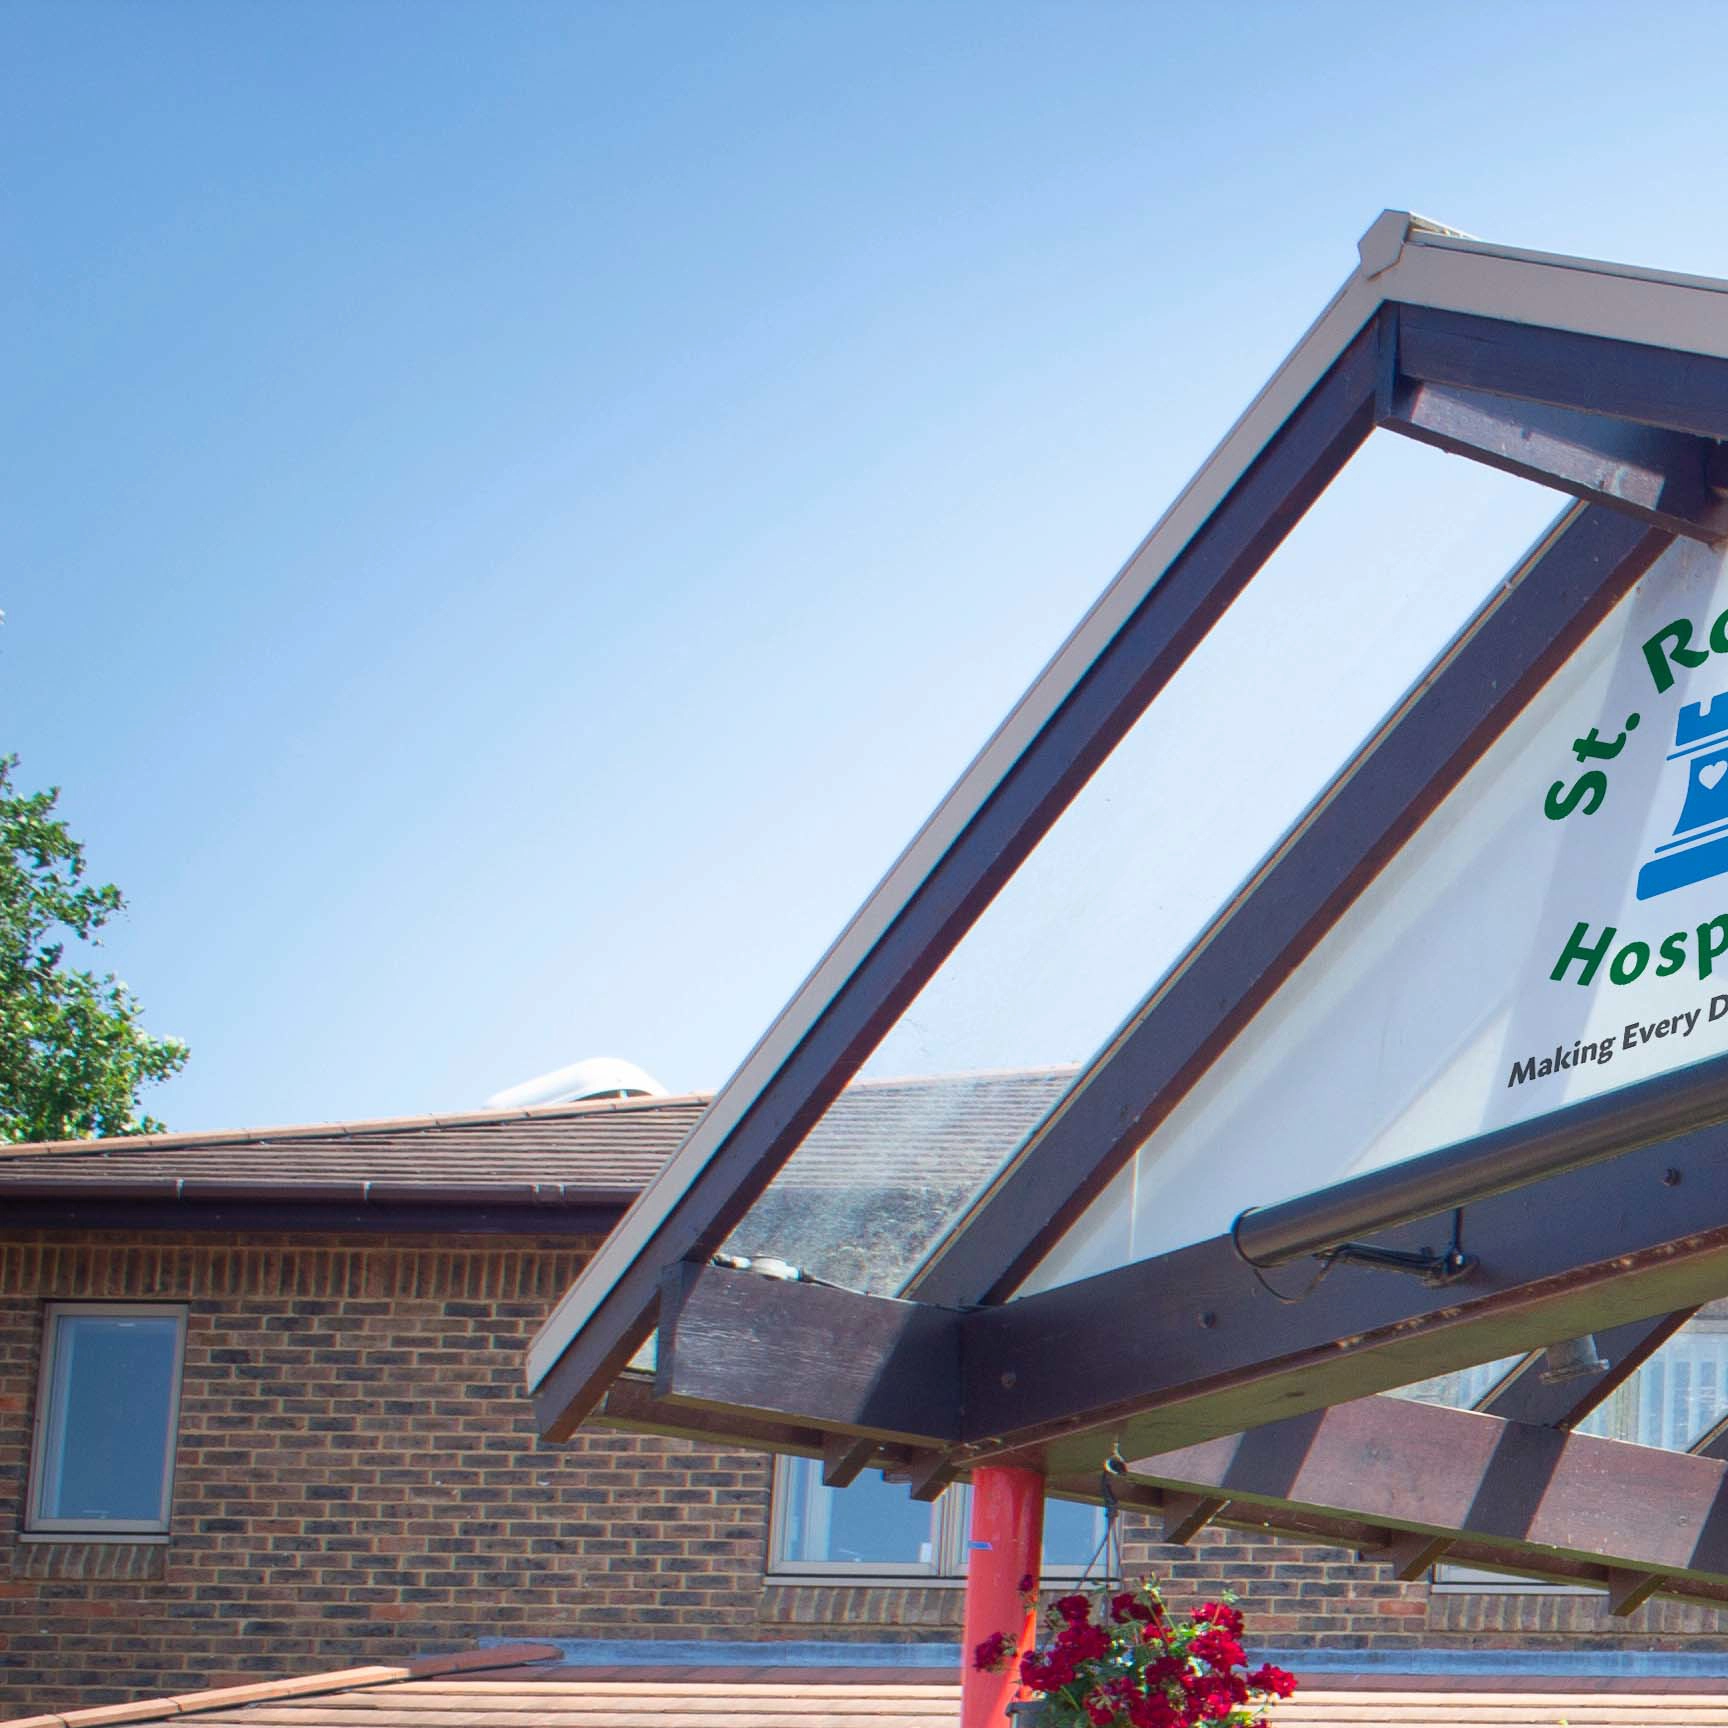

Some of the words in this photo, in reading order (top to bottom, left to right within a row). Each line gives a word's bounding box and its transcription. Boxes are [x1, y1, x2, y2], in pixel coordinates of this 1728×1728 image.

[1543, 711, 1641, 821] St.
[1507, 1032, 1617, 1088] Making
[1622, 1004, 1701, 1050] Every
